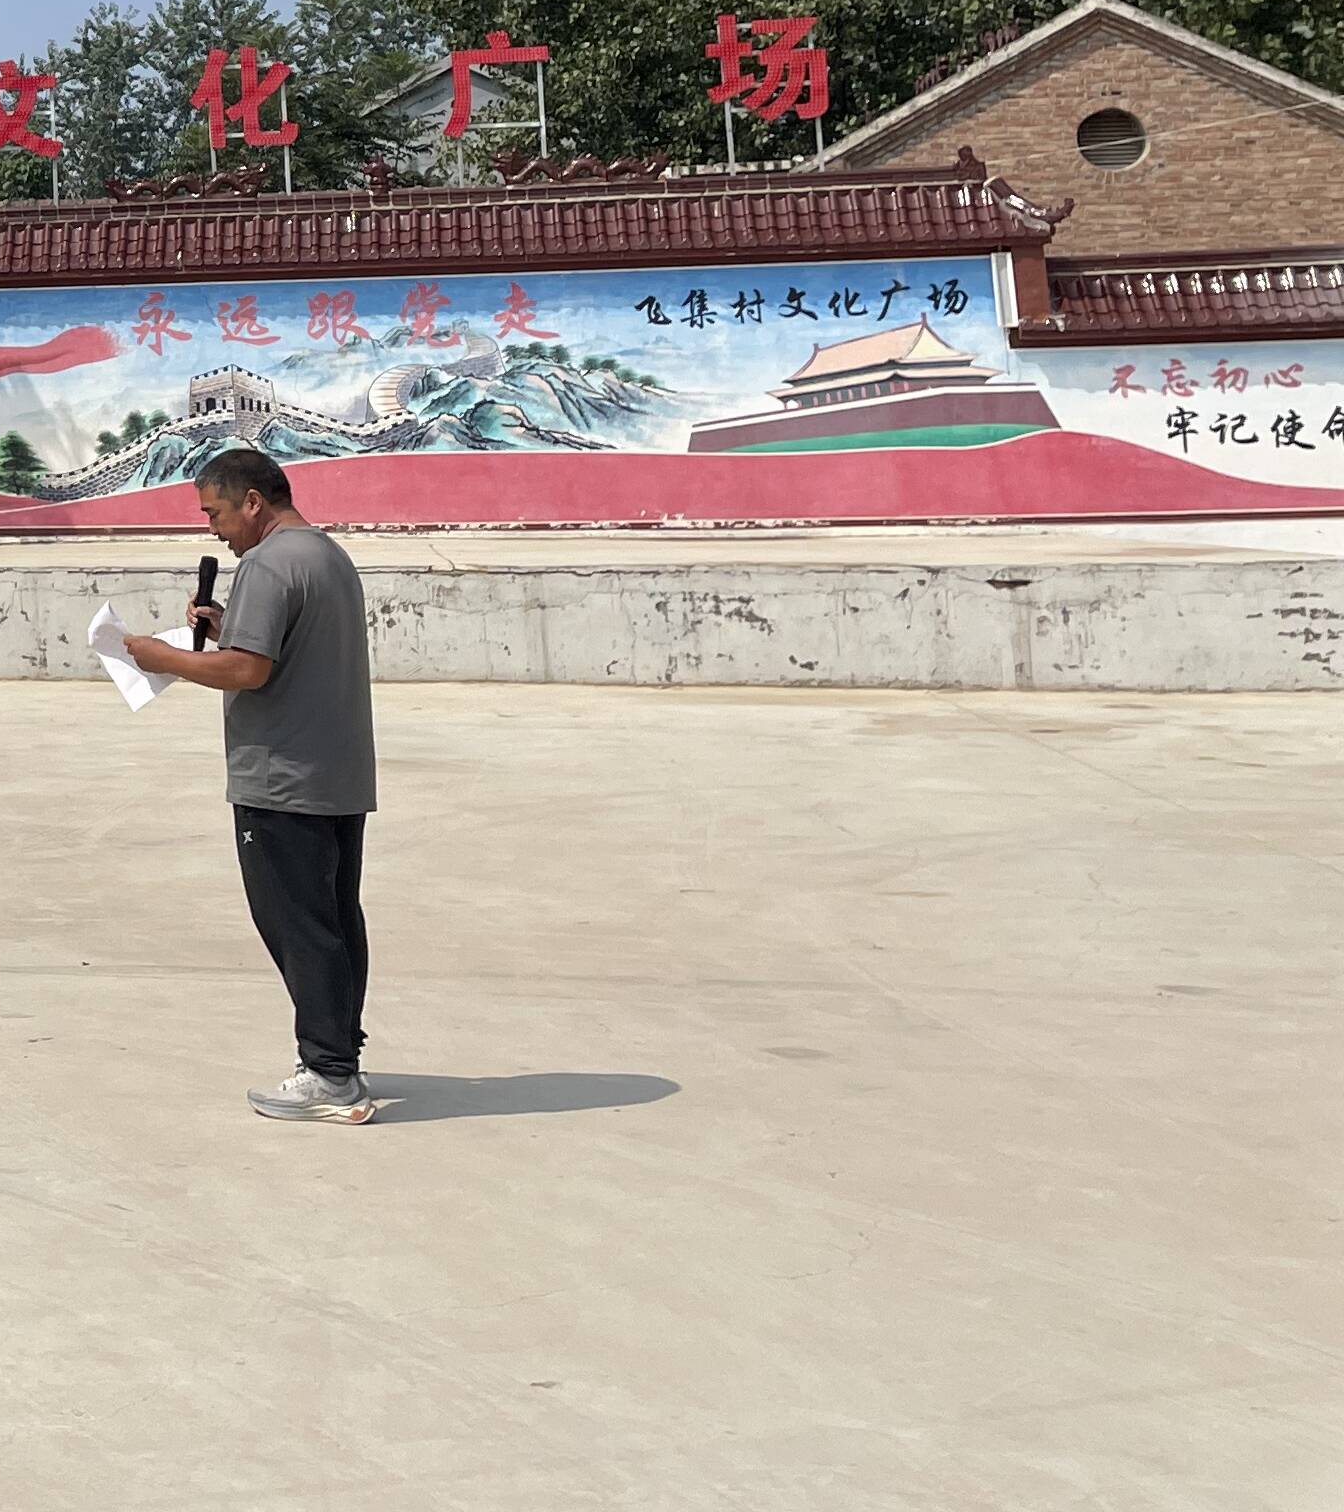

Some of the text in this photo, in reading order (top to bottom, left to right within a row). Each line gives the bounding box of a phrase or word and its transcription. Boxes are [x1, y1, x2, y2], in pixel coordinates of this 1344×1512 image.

[133, 283, 561, 356] 永远跟党走
[634, 278, 970, 328] 飞集村文化广场
[1109, 358, 1305, 399] 不忘初心
